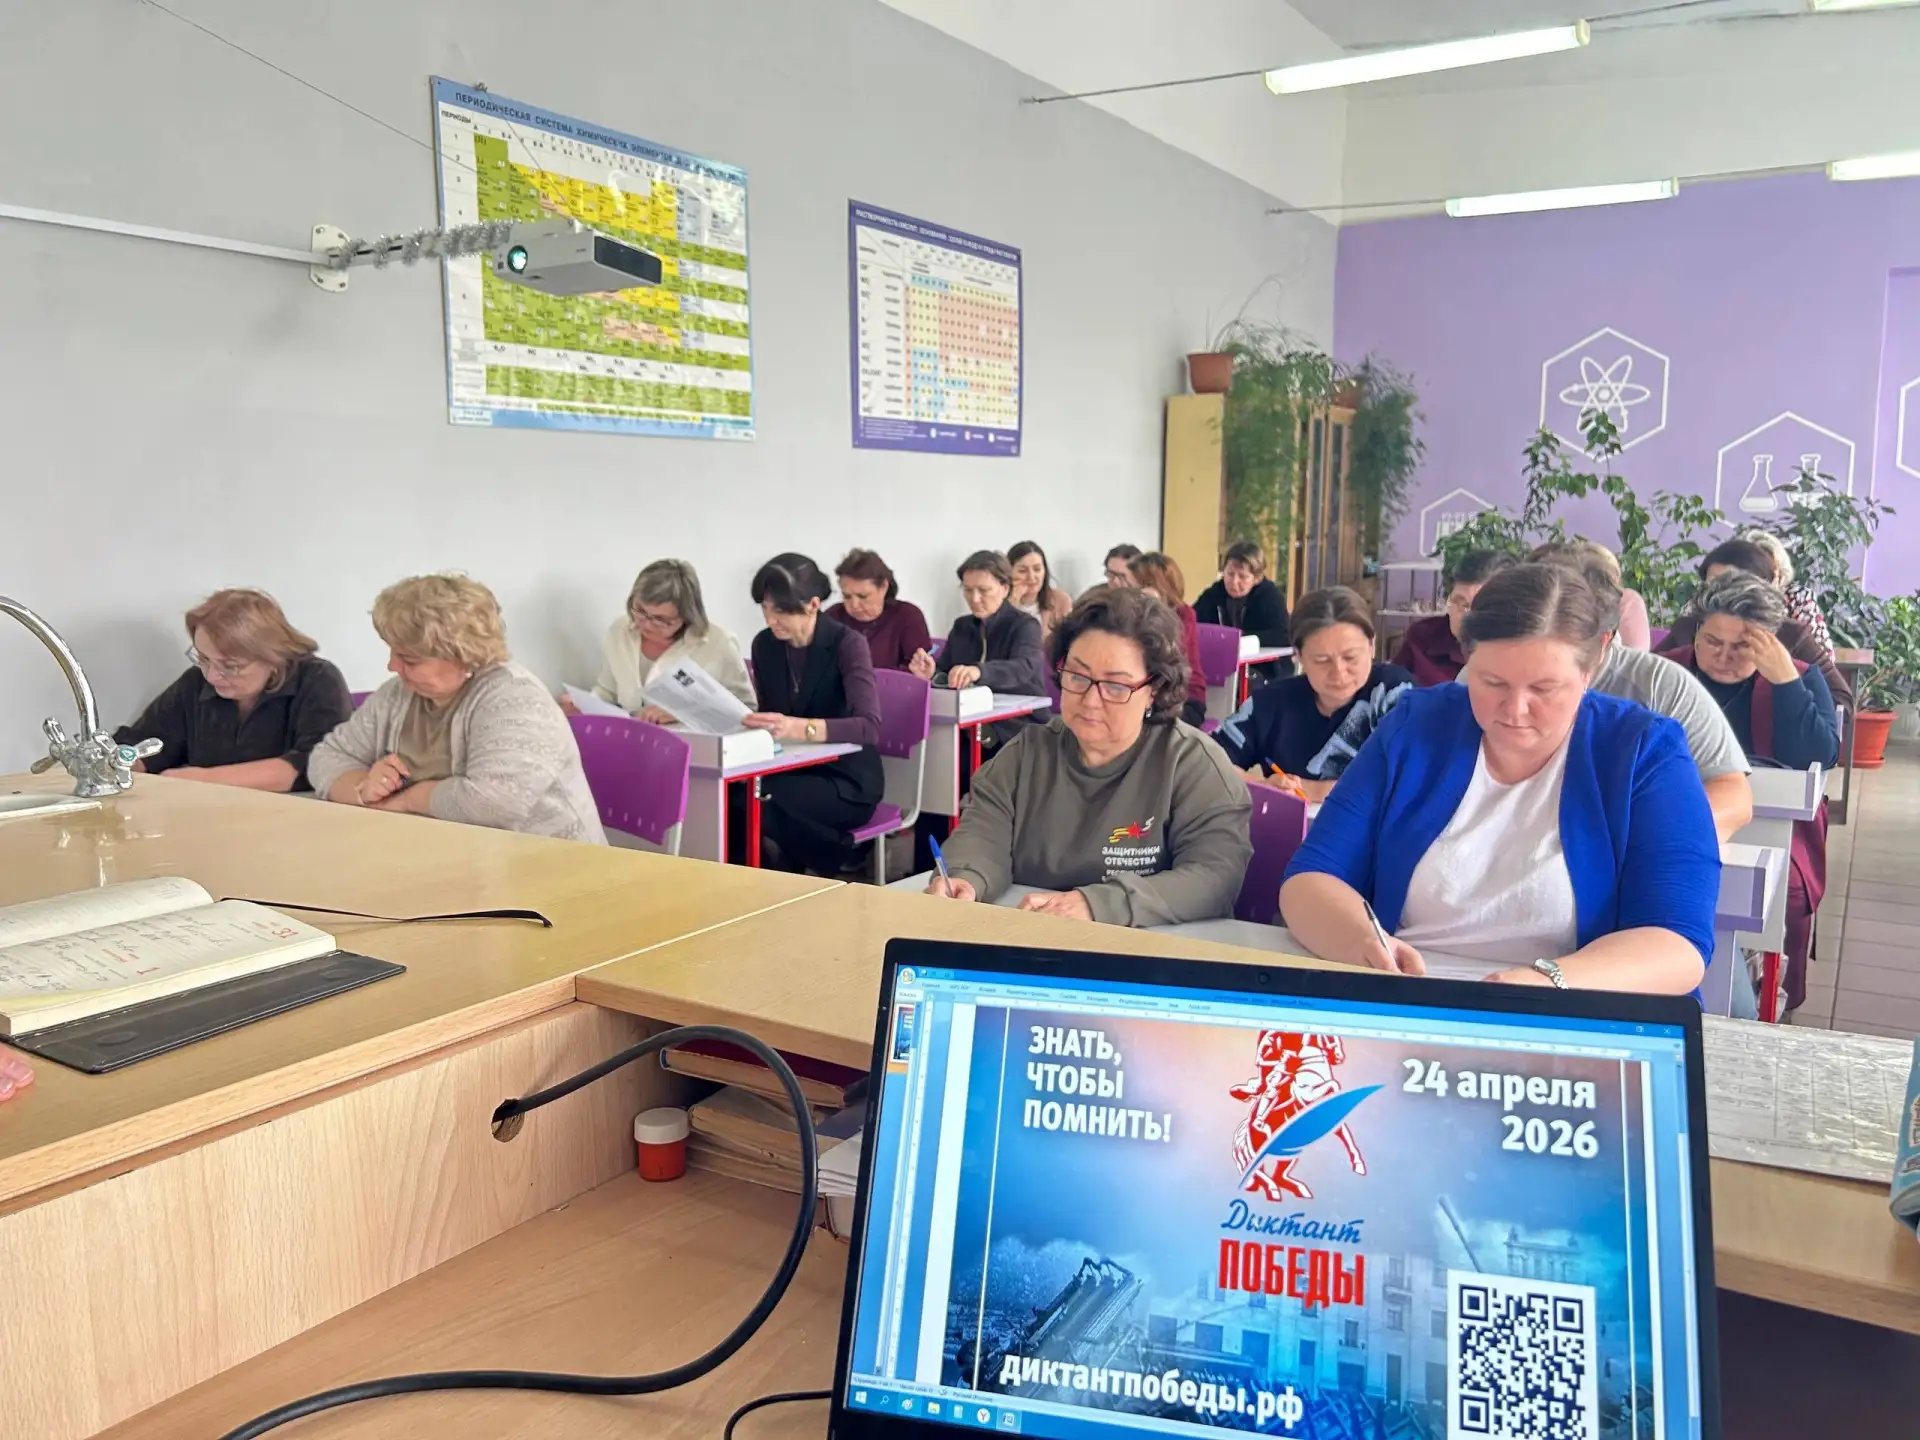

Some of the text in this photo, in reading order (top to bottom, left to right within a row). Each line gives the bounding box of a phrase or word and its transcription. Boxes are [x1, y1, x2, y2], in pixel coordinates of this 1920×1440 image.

[455, 92, 531, 121] ПЕРИОДИЧЕСКАЯ
[535, 116, 573, 134] СИСТЕМА
[1101, 845, 1161, 856] ЗАЩИТНИКИ
[1104, 856, 1157, 866] ОТЕЧЕСТВА
[1028, 1025, 1122, 1066] ЗНАТЬ,
[1026, 1061, 1124, 1099] ЧТОБЫ
[1402, 1058, 1596, 1111] 24 апреля
[1023, 1098, 1172, 1143] ПОМНИТЬ!
[1501, 1115, 1600, 1159] 2026
[1220, 1198, 1365, 1244] Диктант
[1218, 1238, 1365, 1309] ПОБЕДЫ
[999, 1353, 1304, 1429] диктантпобеды.рф
